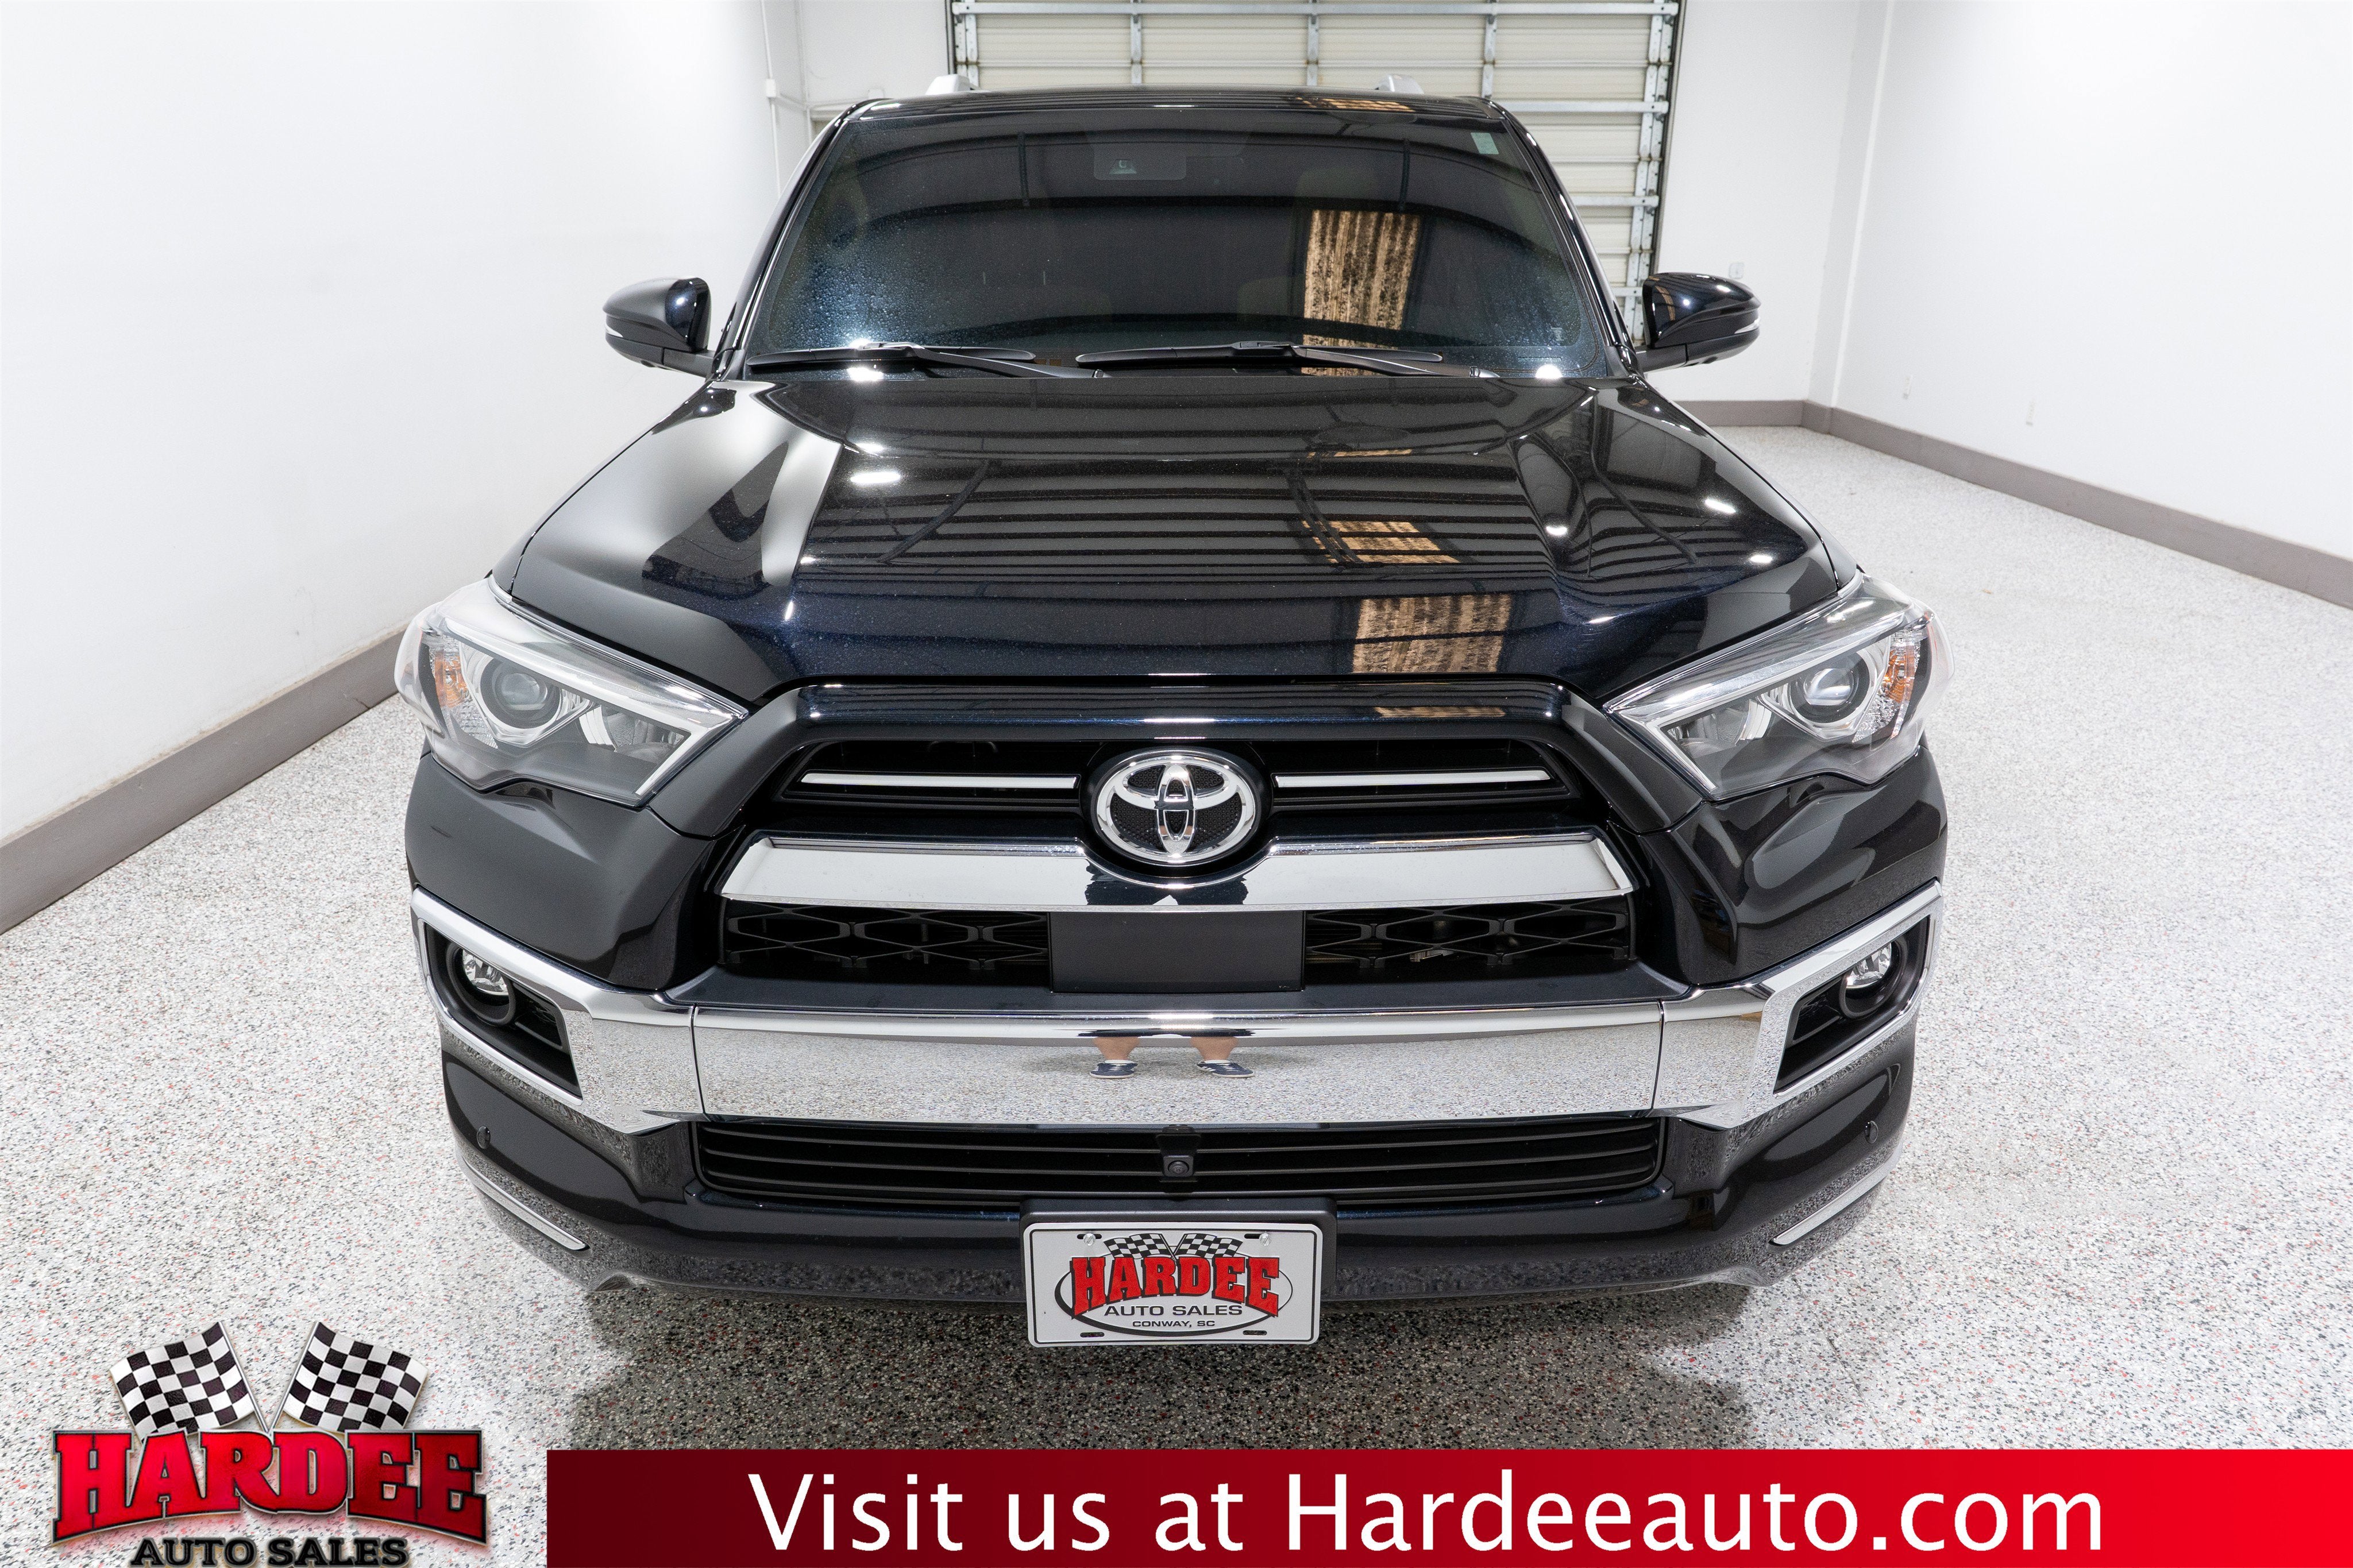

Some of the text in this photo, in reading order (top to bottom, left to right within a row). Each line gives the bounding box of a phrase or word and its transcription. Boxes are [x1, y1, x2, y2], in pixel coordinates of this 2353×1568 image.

[1070, 1256, 1280, 1319] HARDEE
[1104, 1305, 1243, 1316] AUTO SALES
